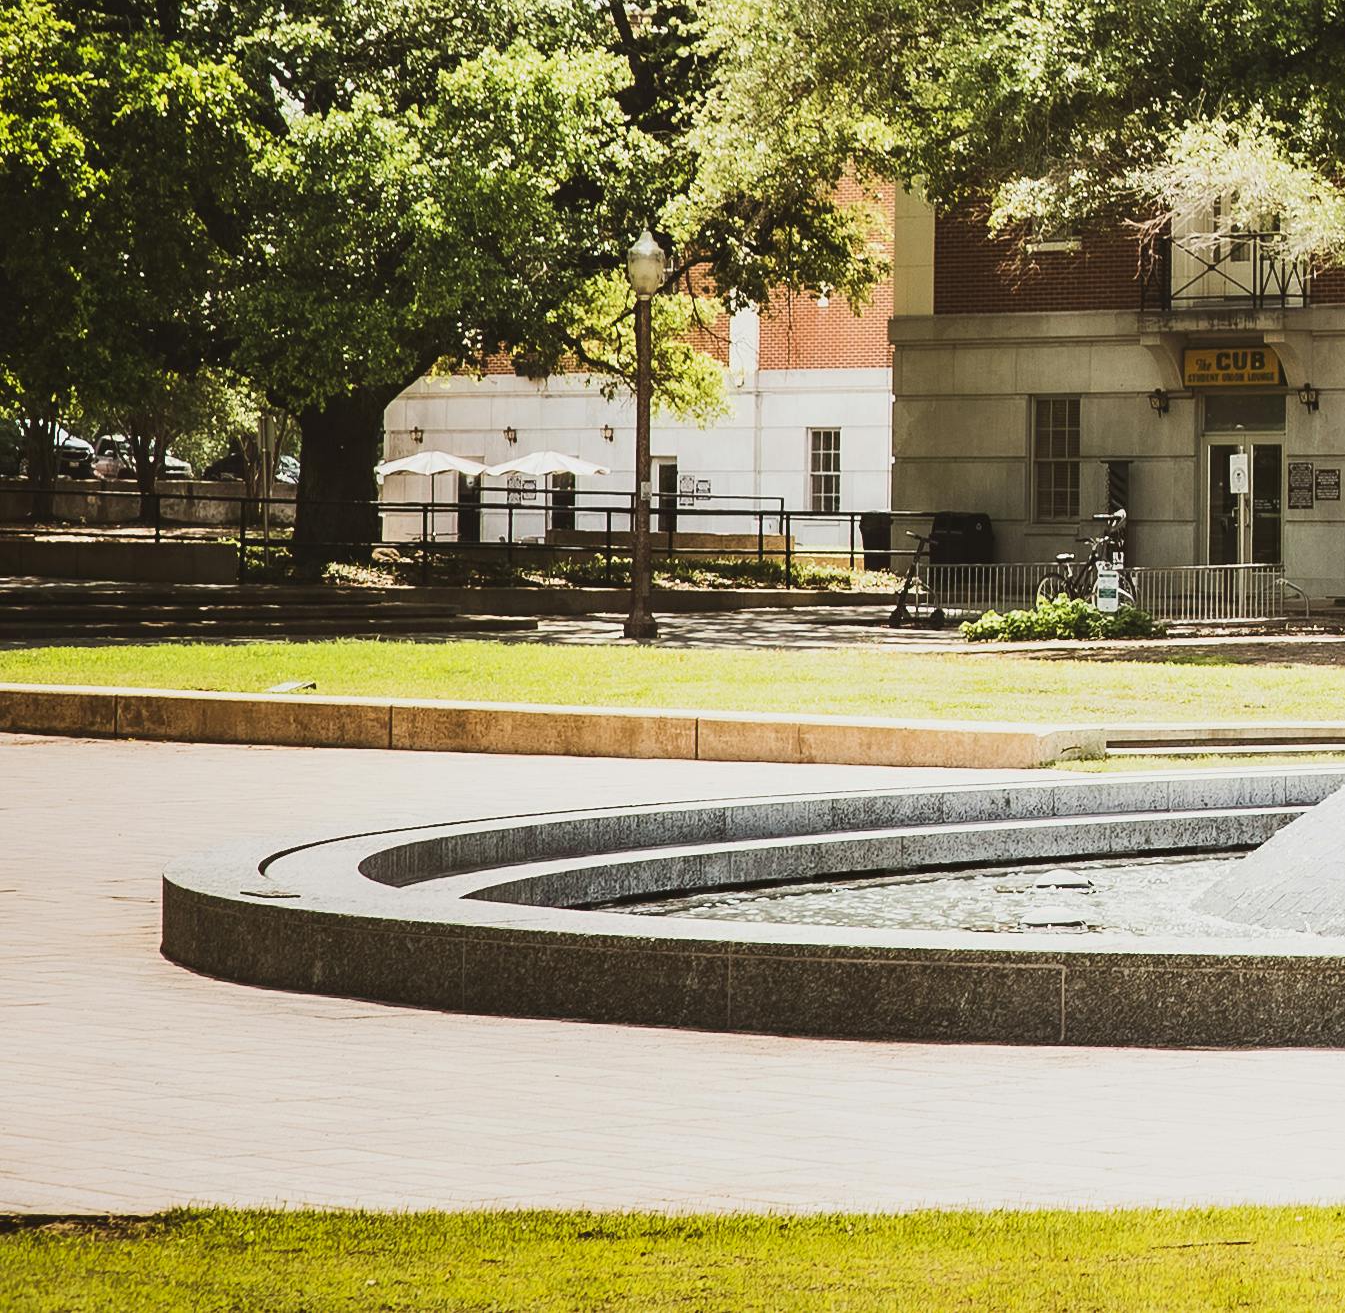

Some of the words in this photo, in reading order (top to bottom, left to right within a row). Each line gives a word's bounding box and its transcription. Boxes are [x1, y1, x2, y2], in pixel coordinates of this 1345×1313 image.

[1195, 358, 1212, 371] The
[1216, 351, 1265, 370] CUB
[1188, 373, 1219, 382] STUDENT
[1248, 373, 1274, 382] LOUNGE
